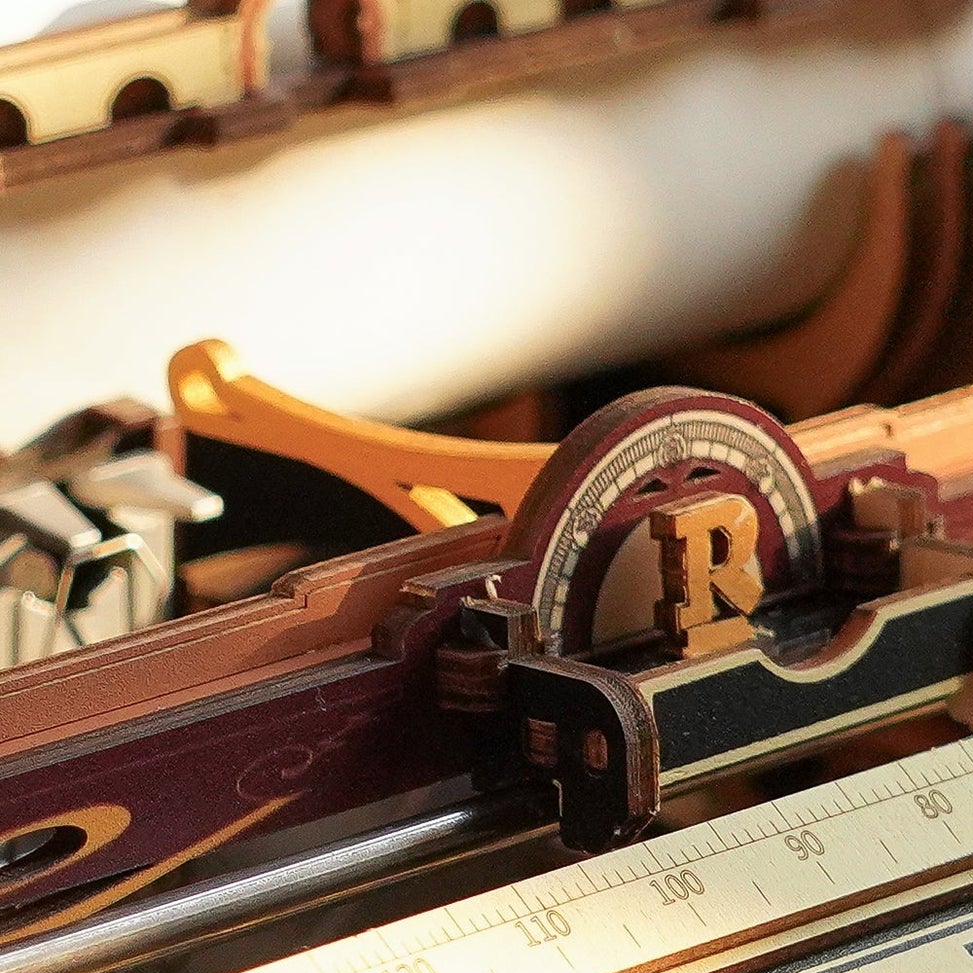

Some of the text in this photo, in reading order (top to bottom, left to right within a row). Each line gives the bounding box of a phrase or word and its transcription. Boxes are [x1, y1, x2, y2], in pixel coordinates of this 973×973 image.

[662, 492, 764, 636] R
[514, 910, 571, 947] 110
[649, 869, 704, 906] 100
[784, 829, 826, 861] 90
[913, 789, 953, 820] 80
